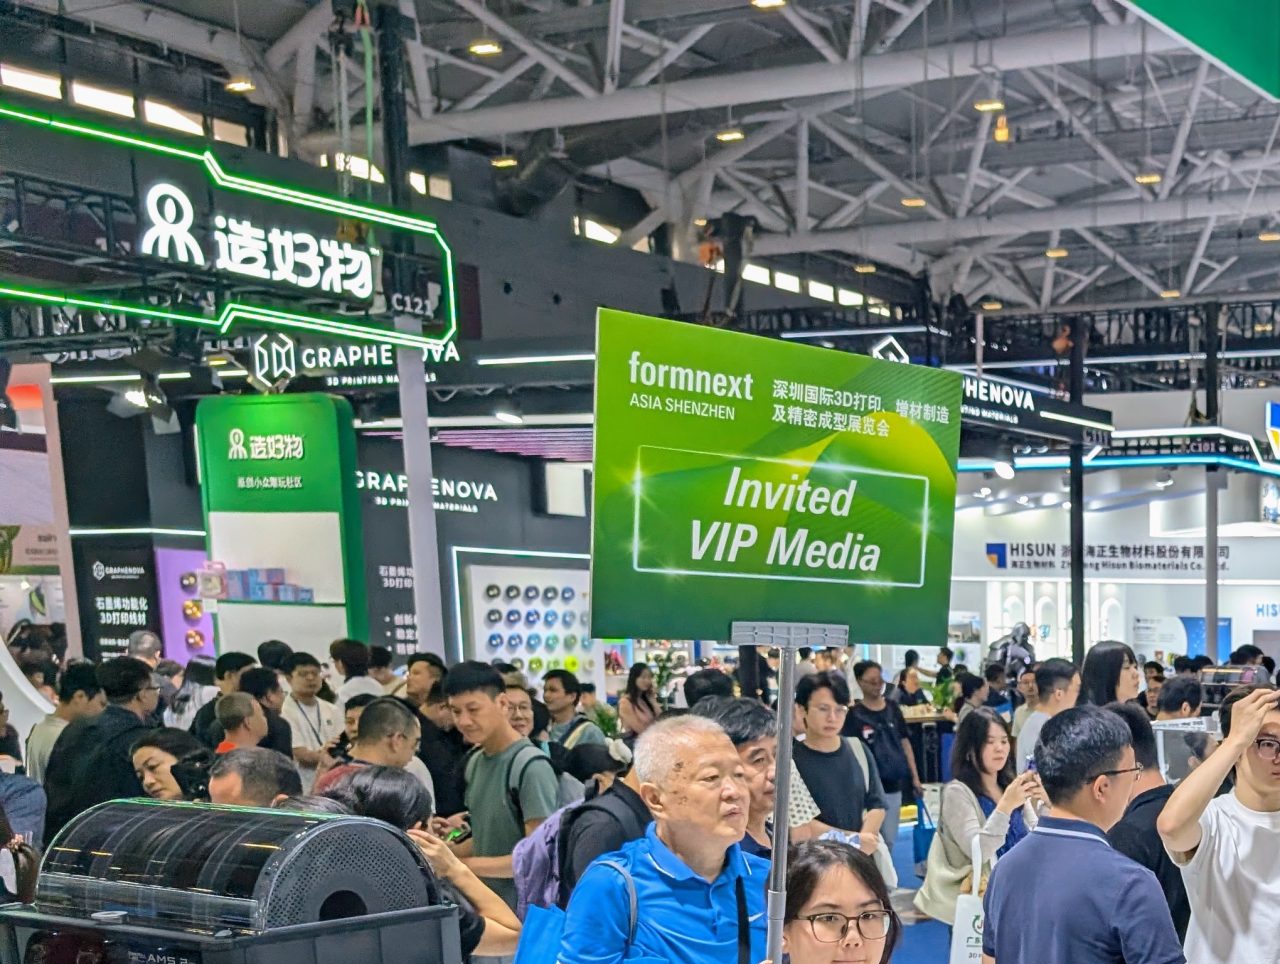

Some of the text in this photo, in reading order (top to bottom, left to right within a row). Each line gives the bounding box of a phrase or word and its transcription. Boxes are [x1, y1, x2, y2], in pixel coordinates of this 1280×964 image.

[214, 216, 373, 299] 造好物
[302, 340, 461, 369] GRAPHEVA
[628, 350, 754, 401] formnext
[629, 393, 736, 421] ASIA SHENZHEN
[771, 379, 950, 425] 深圳国际3D打印、增材制造
[961, 376, 1035, 412] HENOVA
[771, 404, 890, 438] 及精密成型展览会
[249, 434, 304, 460] 造好物
[355, 470, 499, 502] GRAPENOVA
[723, 466, 857, 518] Invited
[690, 519, 882, 573] VIP Media
[1010, 543, 1230, 559] HISUN 浙海正生物材料股份有限司
[1060, 560, 1100, 572] Zhang
